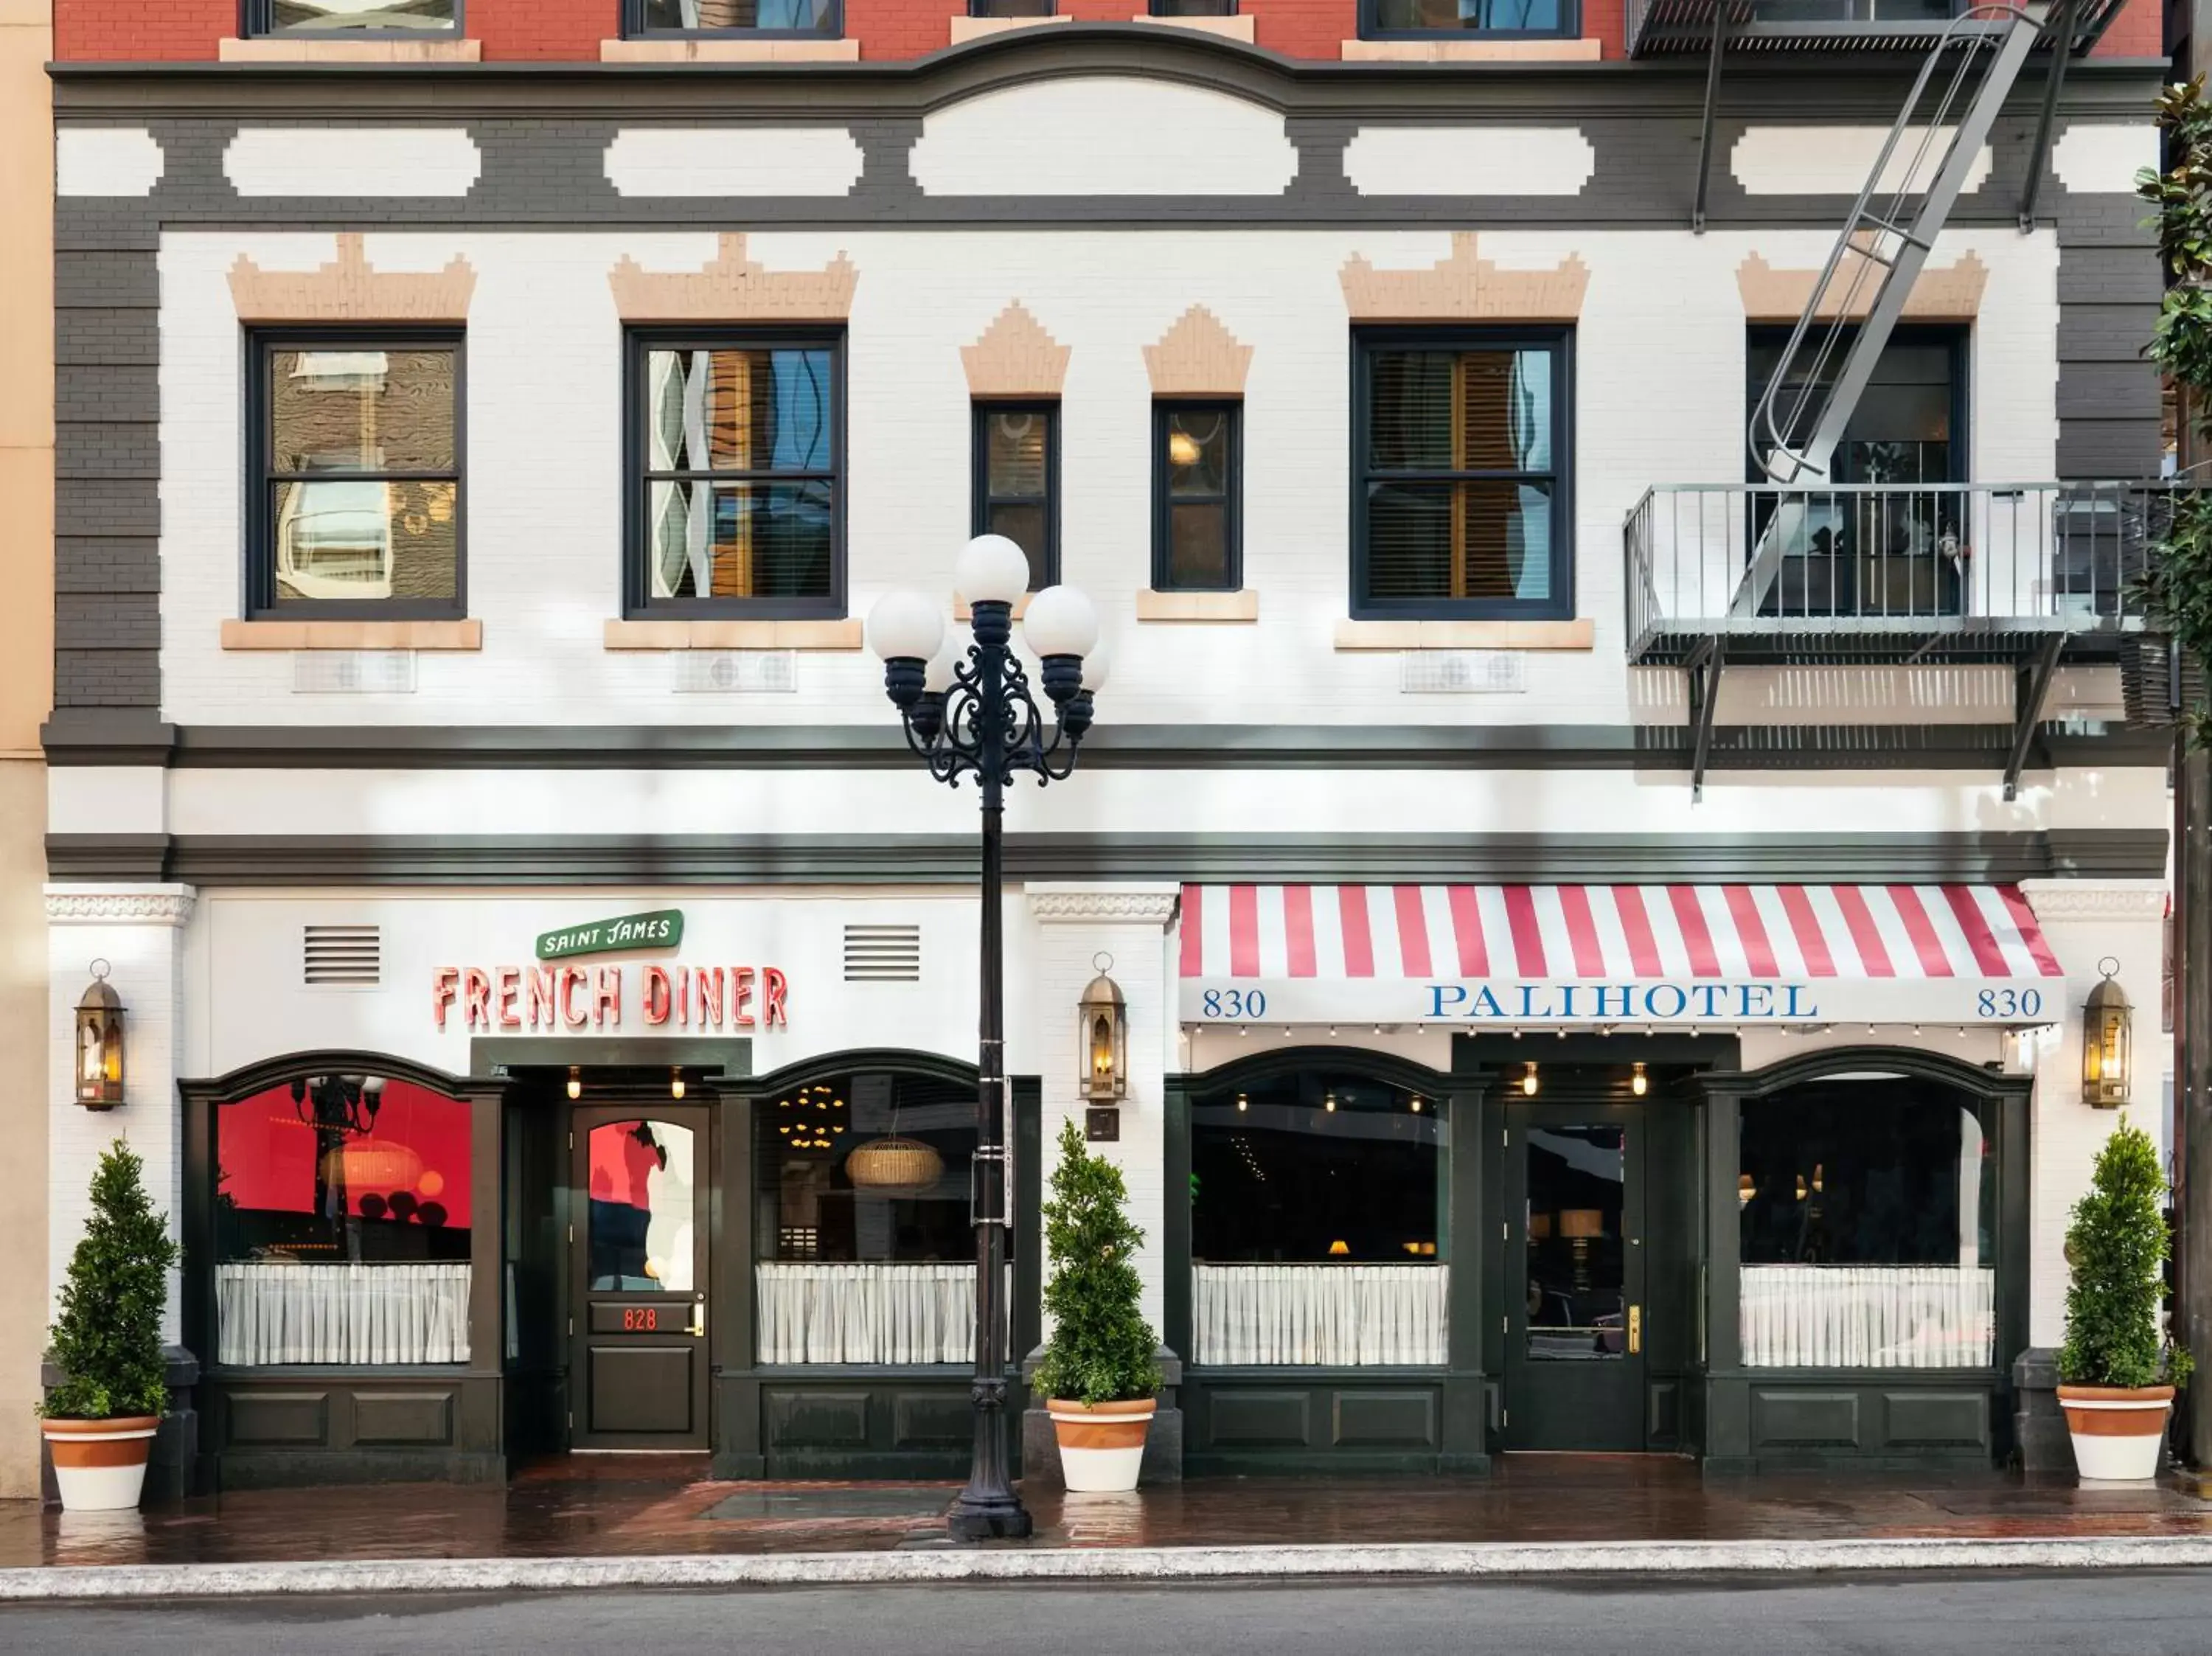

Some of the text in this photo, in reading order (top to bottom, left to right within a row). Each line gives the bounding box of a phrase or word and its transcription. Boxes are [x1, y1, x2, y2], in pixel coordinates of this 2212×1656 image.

[544, 919, 671, 953] SAINT JAMES
[432, 966, 788, 1026] FRENCH DINER
[1203, 989, 1266, 1018] 830
[1424, 984, 1818, 1017] PALIHOTEL
[1978, 989, 2041, 1017] 830
[625, 1309, 656, 1331] 828
